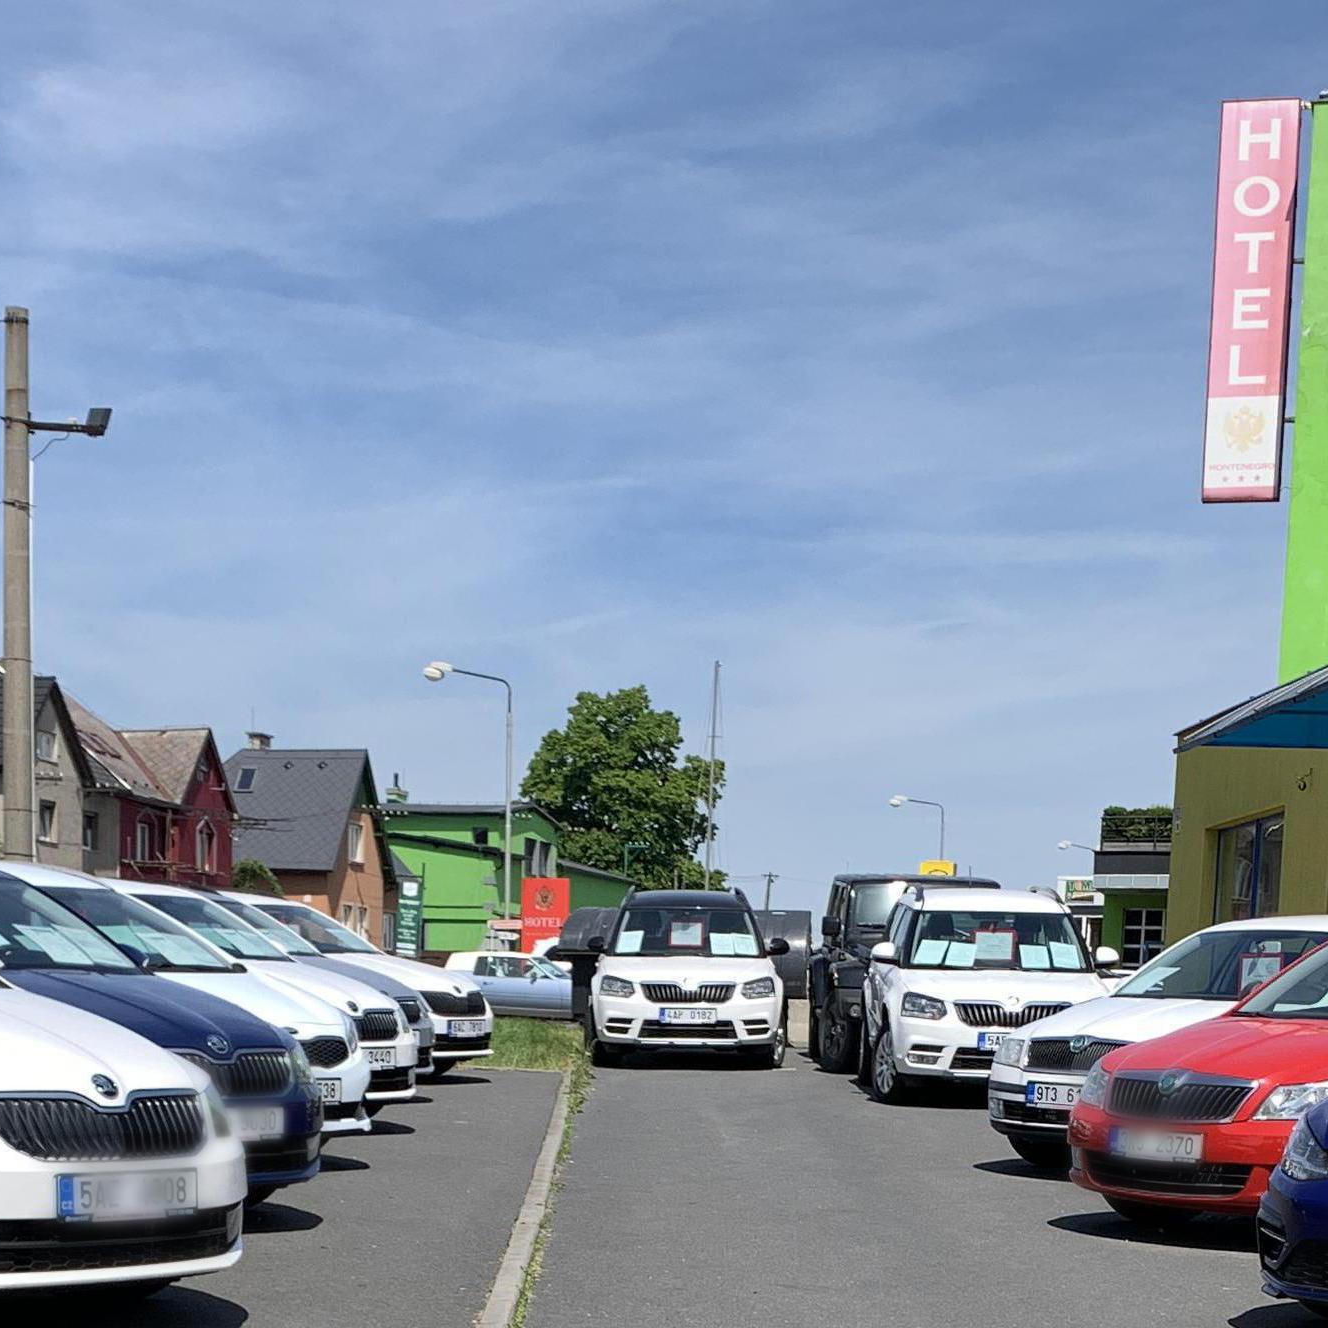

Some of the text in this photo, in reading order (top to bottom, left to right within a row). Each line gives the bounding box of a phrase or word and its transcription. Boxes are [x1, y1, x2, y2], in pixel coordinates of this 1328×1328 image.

[1228, 118, 1282, 386] HOTEL
[524, 916, 562, 927] HOTEL
[368, 1051, 392, 1064] 3440
[1036, 1086, 1058, 1101] 9T3
